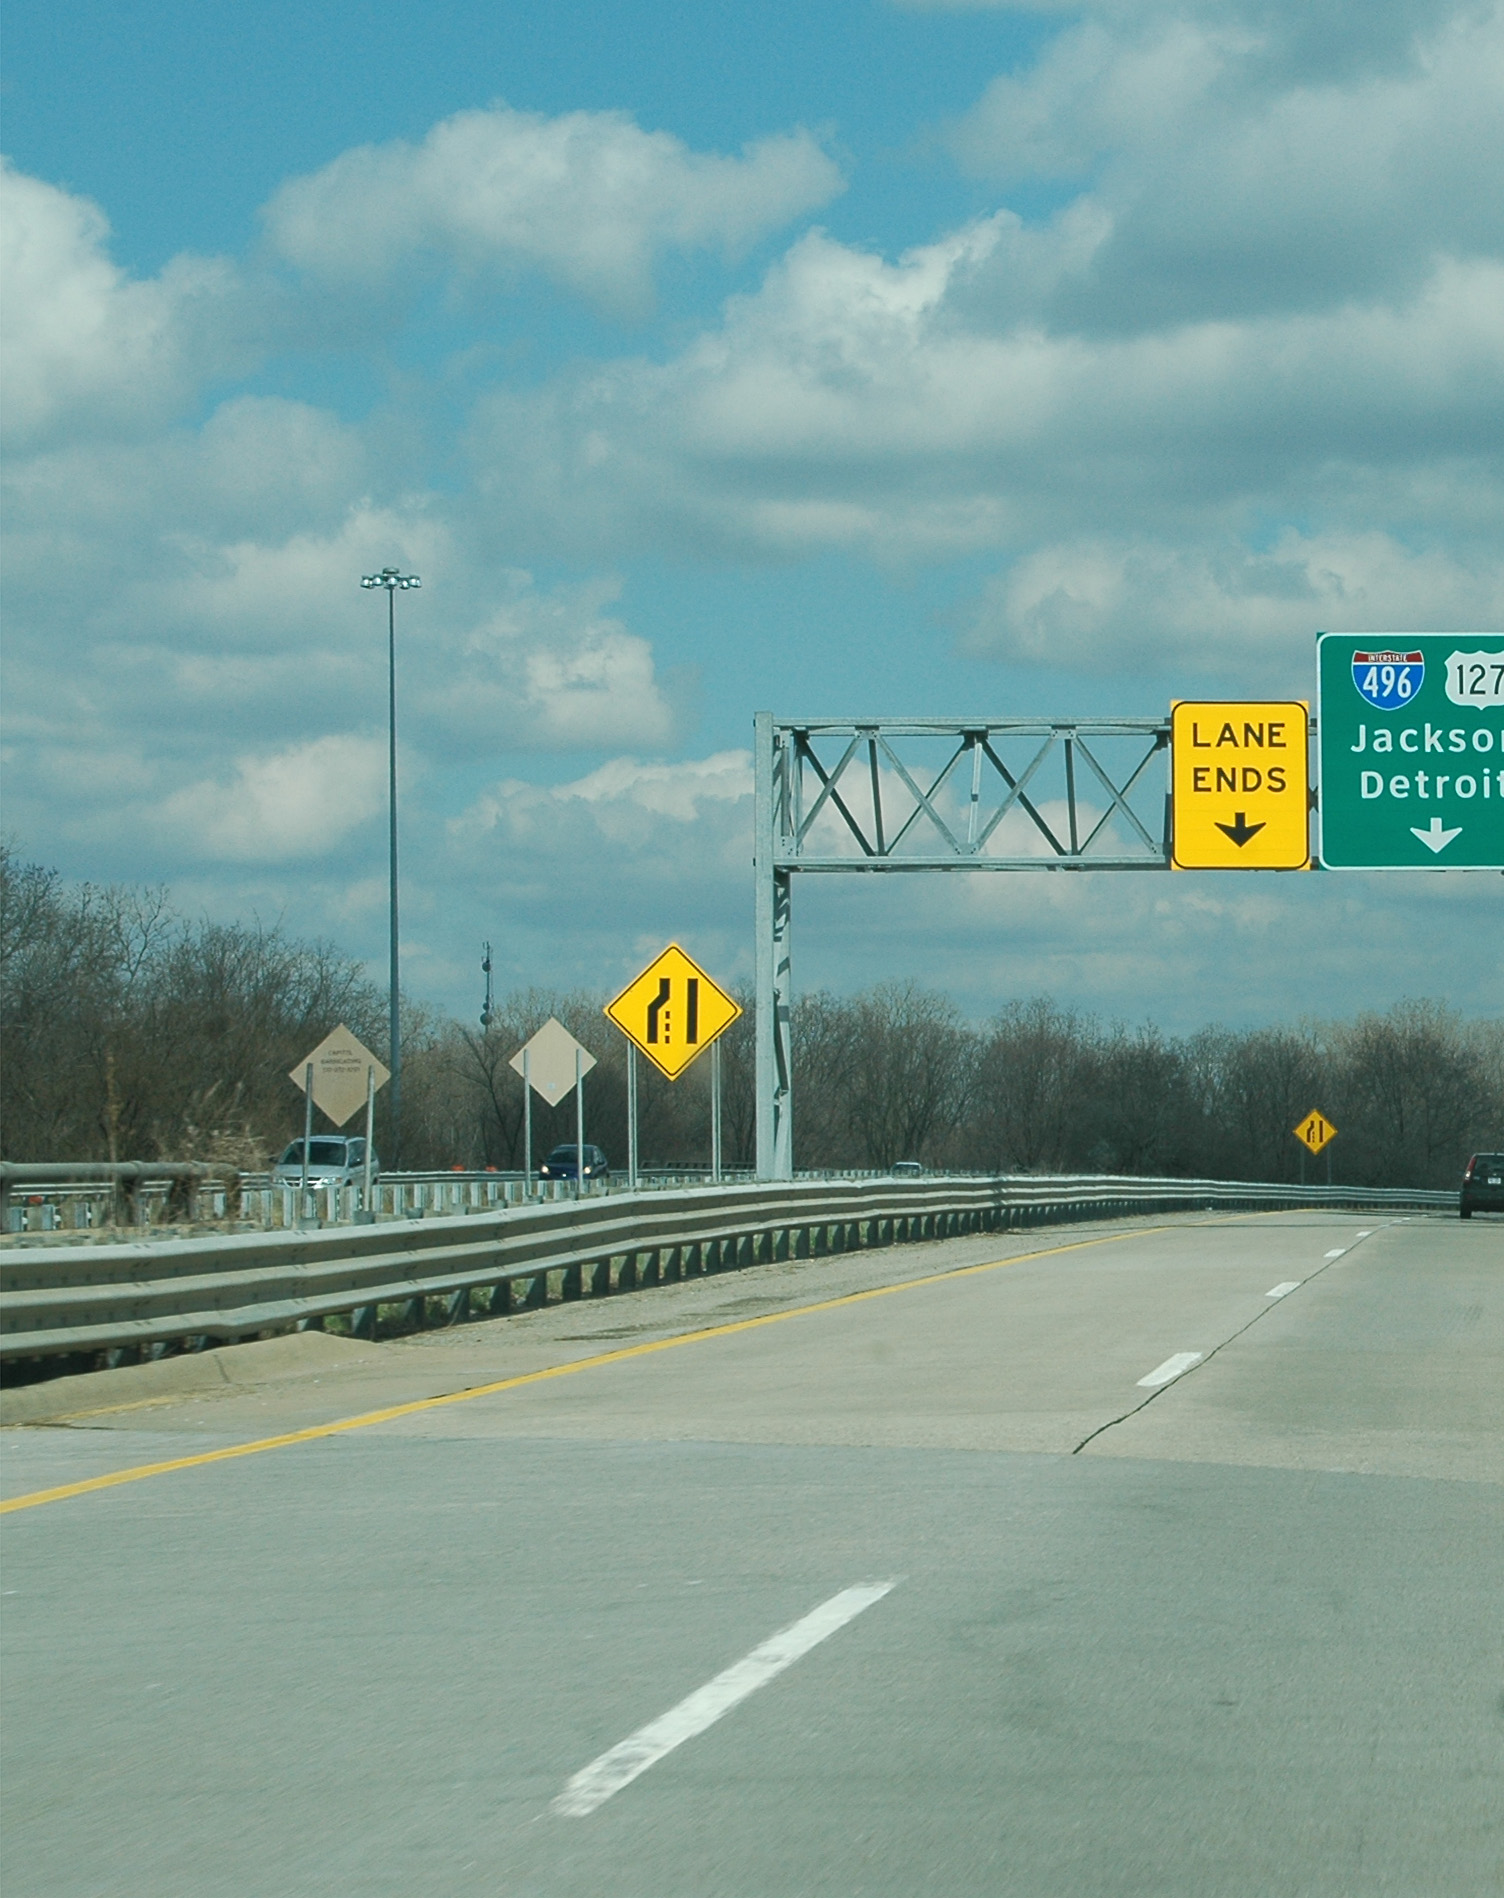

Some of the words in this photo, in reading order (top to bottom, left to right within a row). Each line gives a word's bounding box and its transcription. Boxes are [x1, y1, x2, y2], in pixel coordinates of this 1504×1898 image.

[1368, 653, 1408, 663] INTERSTATE
[1363, 666, 1412, 698] 496
[1193, 723, 1286, 747] LANE
[1193, 767, 1286, 792] ENDS
